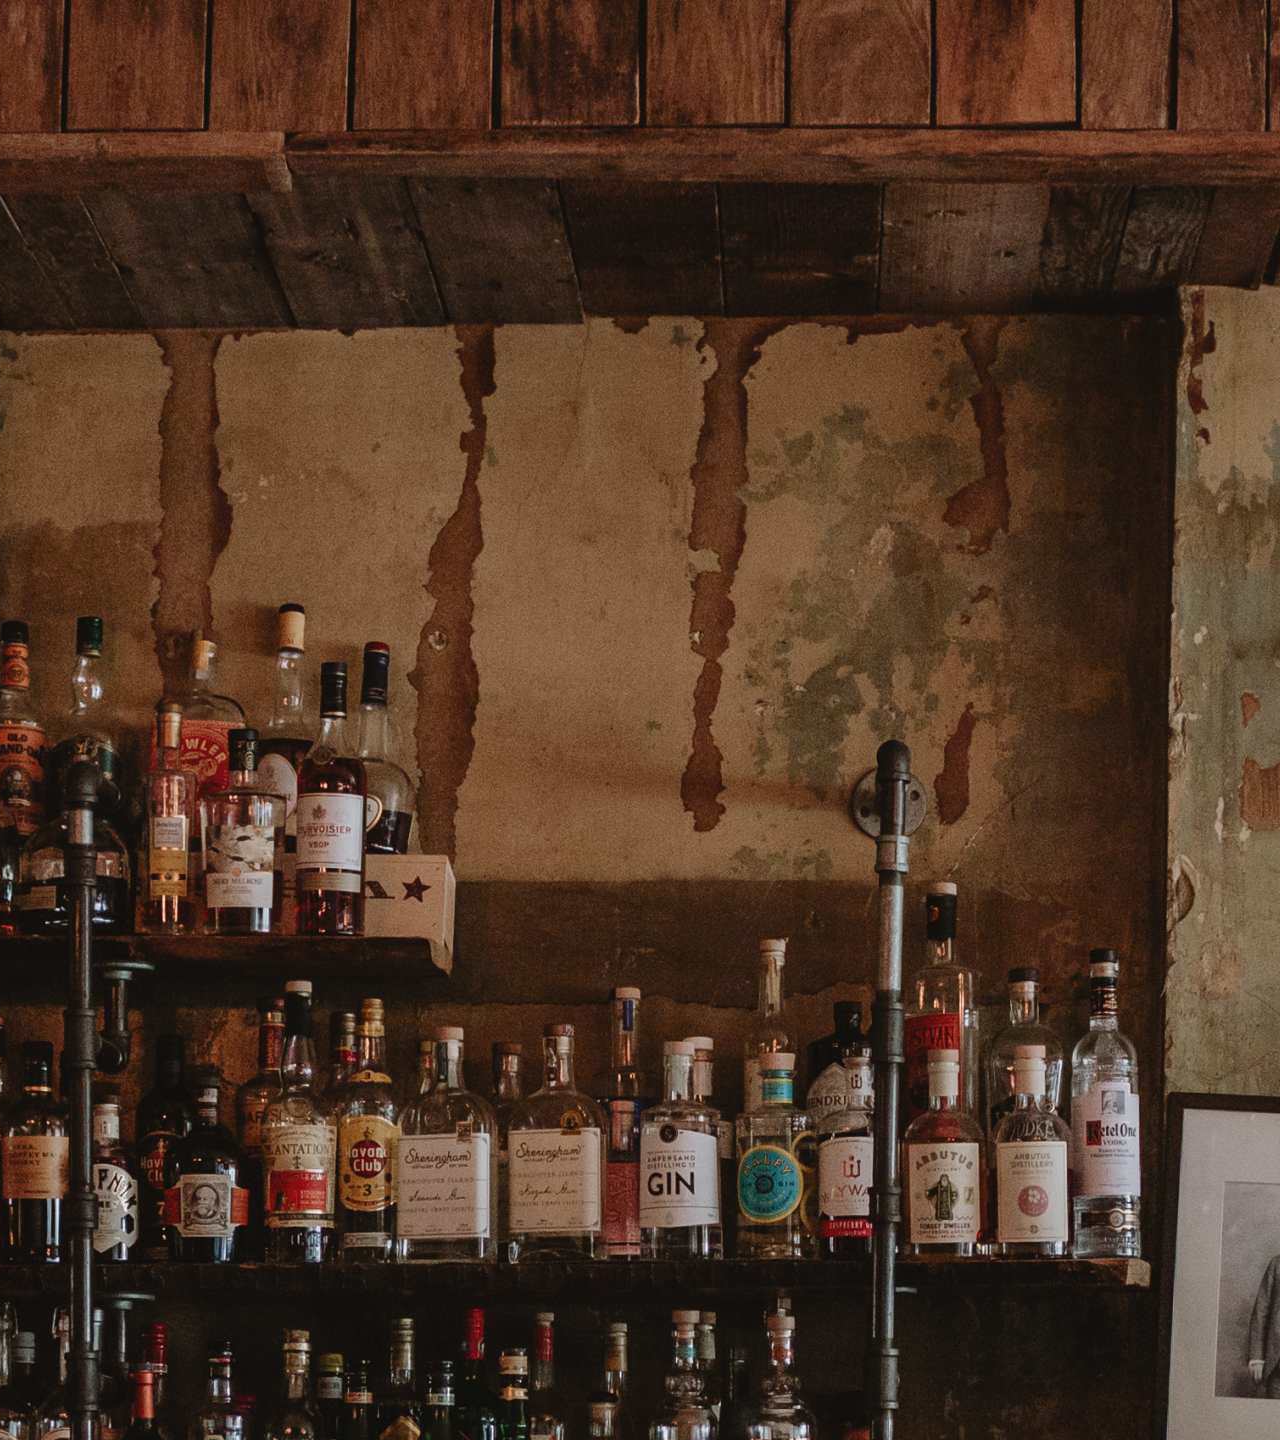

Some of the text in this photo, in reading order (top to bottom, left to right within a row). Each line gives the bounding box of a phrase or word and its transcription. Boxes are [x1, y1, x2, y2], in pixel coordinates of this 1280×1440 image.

[1120, 1123, 1137, 1138] One
[404, 1147, 472, 1169] Sheringham
[647, 1154, 696, 1162] AMPERSAND
[915, 1150, 974, 1171] ARBUTUS
[1014, 1152, 1052, 1161] ARBUTUS
[353, 1159, 382, 1172] Club
[362, 1184, 372, 1197] 3
[647, 1171, 696, 1196] GIN
